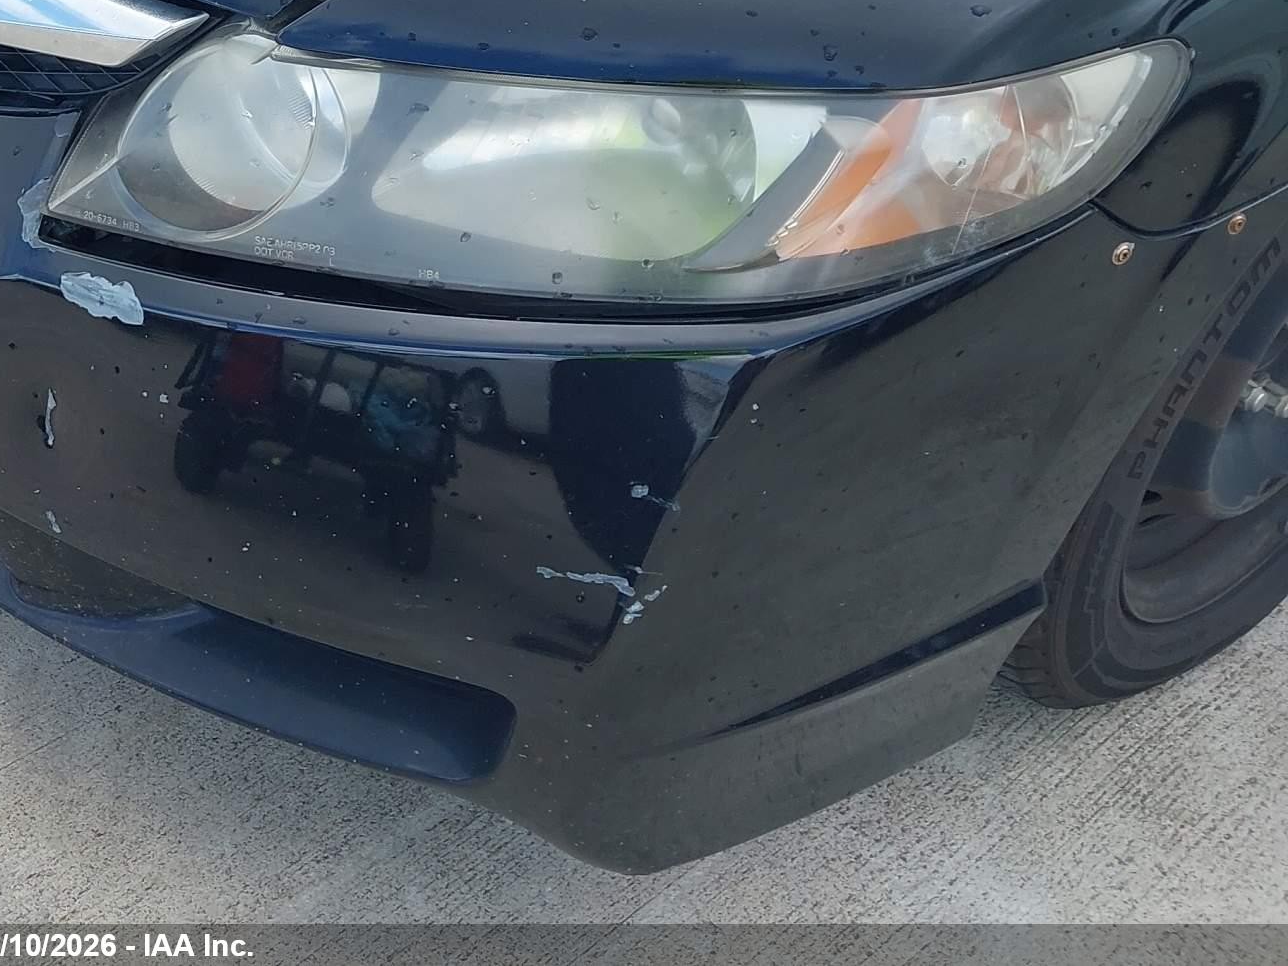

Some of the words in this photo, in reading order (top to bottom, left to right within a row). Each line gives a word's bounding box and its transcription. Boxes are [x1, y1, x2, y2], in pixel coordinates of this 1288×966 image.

[83, 210, 117, 226] 20-6734
[254, 235, 273, 247] SAE
[254, 246, 274, 257] DOT
[418, 269, 440, 279] HB4
